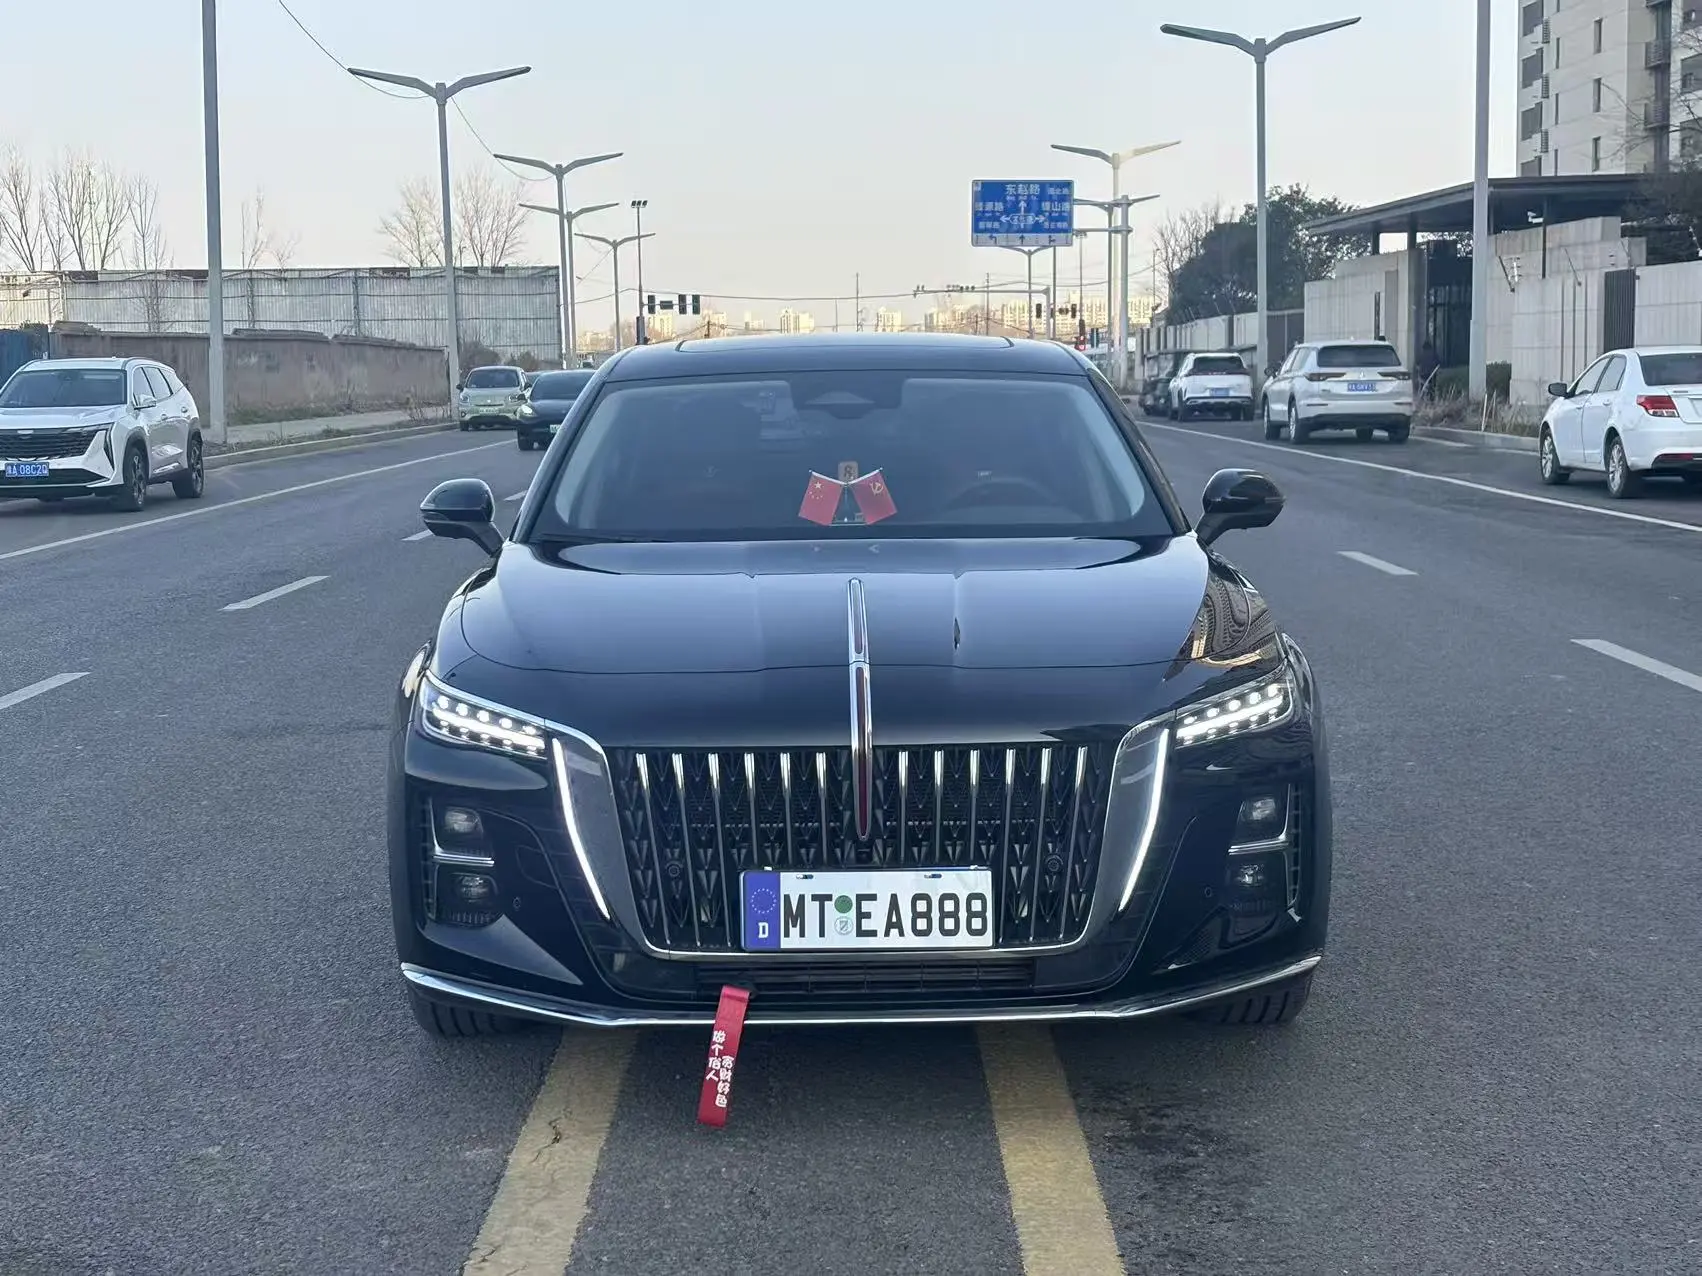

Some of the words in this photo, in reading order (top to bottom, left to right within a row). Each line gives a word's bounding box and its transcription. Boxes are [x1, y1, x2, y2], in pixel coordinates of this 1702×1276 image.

[758, 922, 769, 938] D
[715, 1055, 735, 1108] 贪财好色
